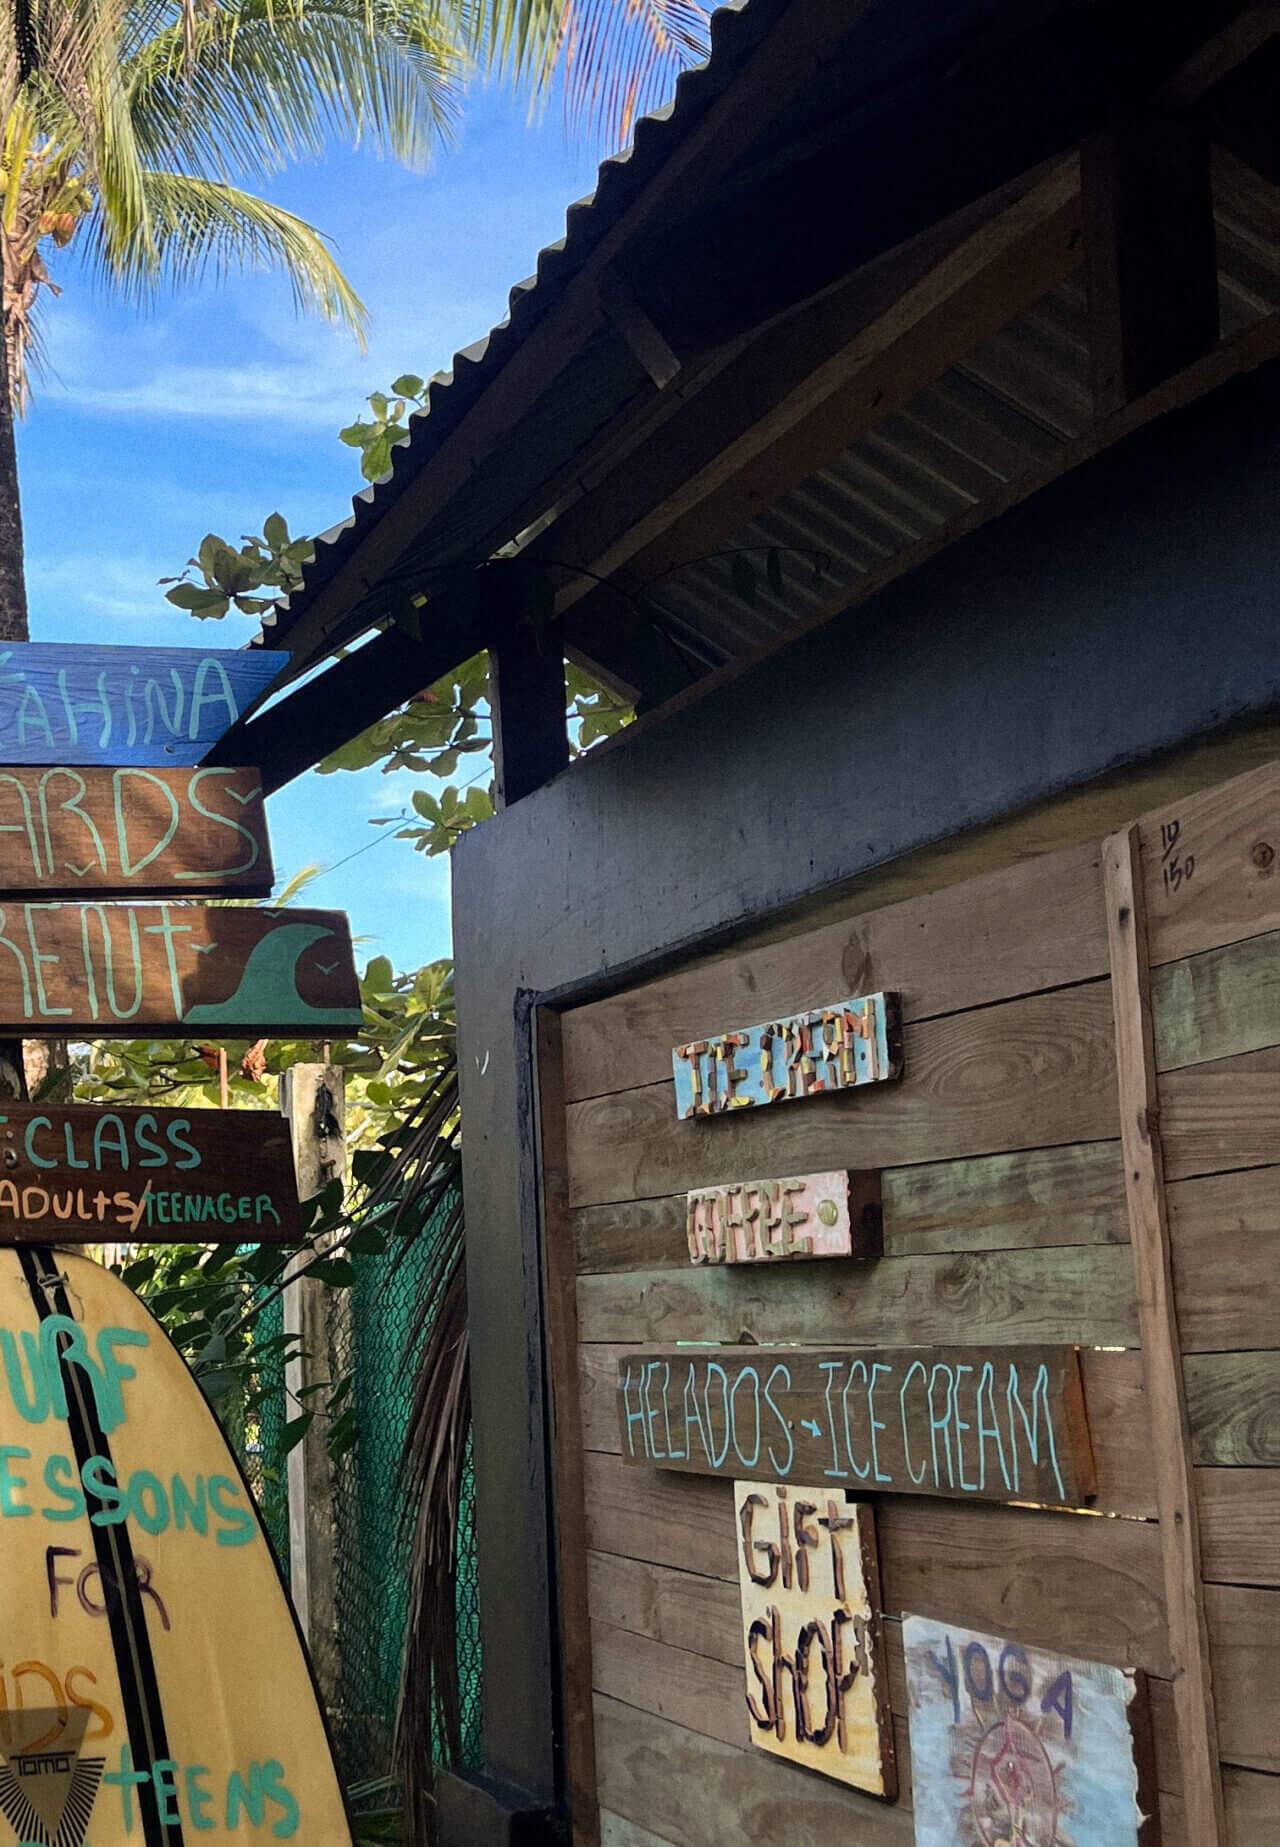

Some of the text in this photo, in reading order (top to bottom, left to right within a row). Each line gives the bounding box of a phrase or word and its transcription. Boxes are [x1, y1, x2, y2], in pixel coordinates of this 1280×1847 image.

[23, 1112, 203, 1172] CLASS
[624, 1360, 1065, 1500] HELADOS ICE CREAM
[927, 1635, 1073, 1740] YOGA
